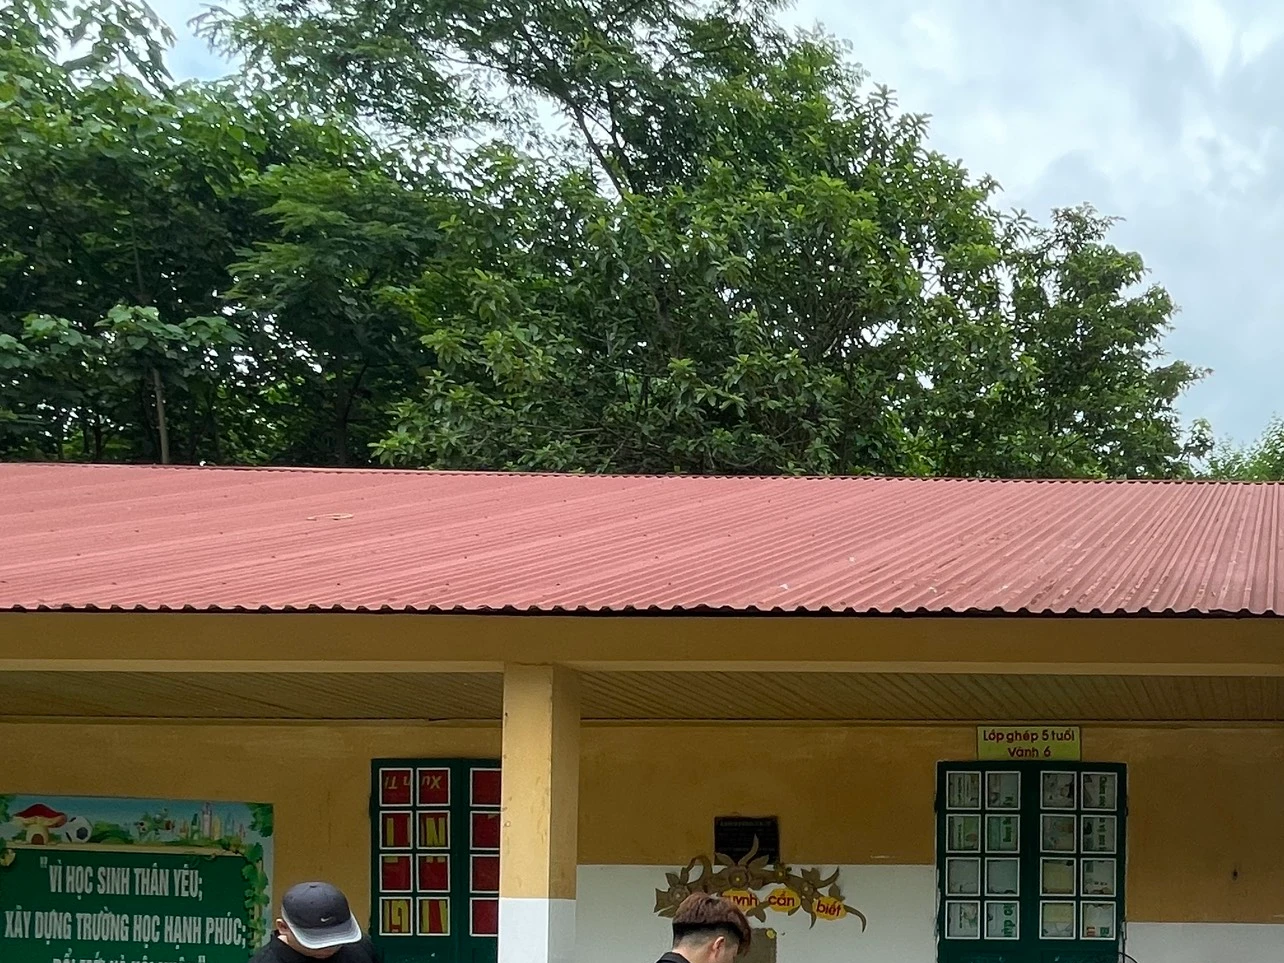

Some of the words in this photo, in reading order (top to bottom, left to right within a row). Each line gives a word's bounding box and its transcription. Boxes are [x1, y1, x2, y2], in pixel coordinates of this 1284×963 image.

[983, 729, 1005, 743] Lớp
[1006, 730, 1039, 744] ghép
[1042, 729, 1049, 741] 5
[1051, 728, 1075, 741] tuổi
[1043, 746, 1051, 757] 6
[66, 865, 94, 900] HỌC
[97, 867, 130, 895] SINH
[134, 862, 169, 896] THÂN
[173, 863, 203, 901] YÊU;
[768, 891, 796, 907] cần
[815, 899, 842, 917] biết
[4, 904, 31, 938] XÂY
[35, 908, 72, 945] DỰNG
[76, 906, 130, 941] TRƯỜNG
[133, 914, 160, 949] HỌC
[164, 915, 202, 949] HẠNH
[205, 911, 247, 949] PHÚC;
